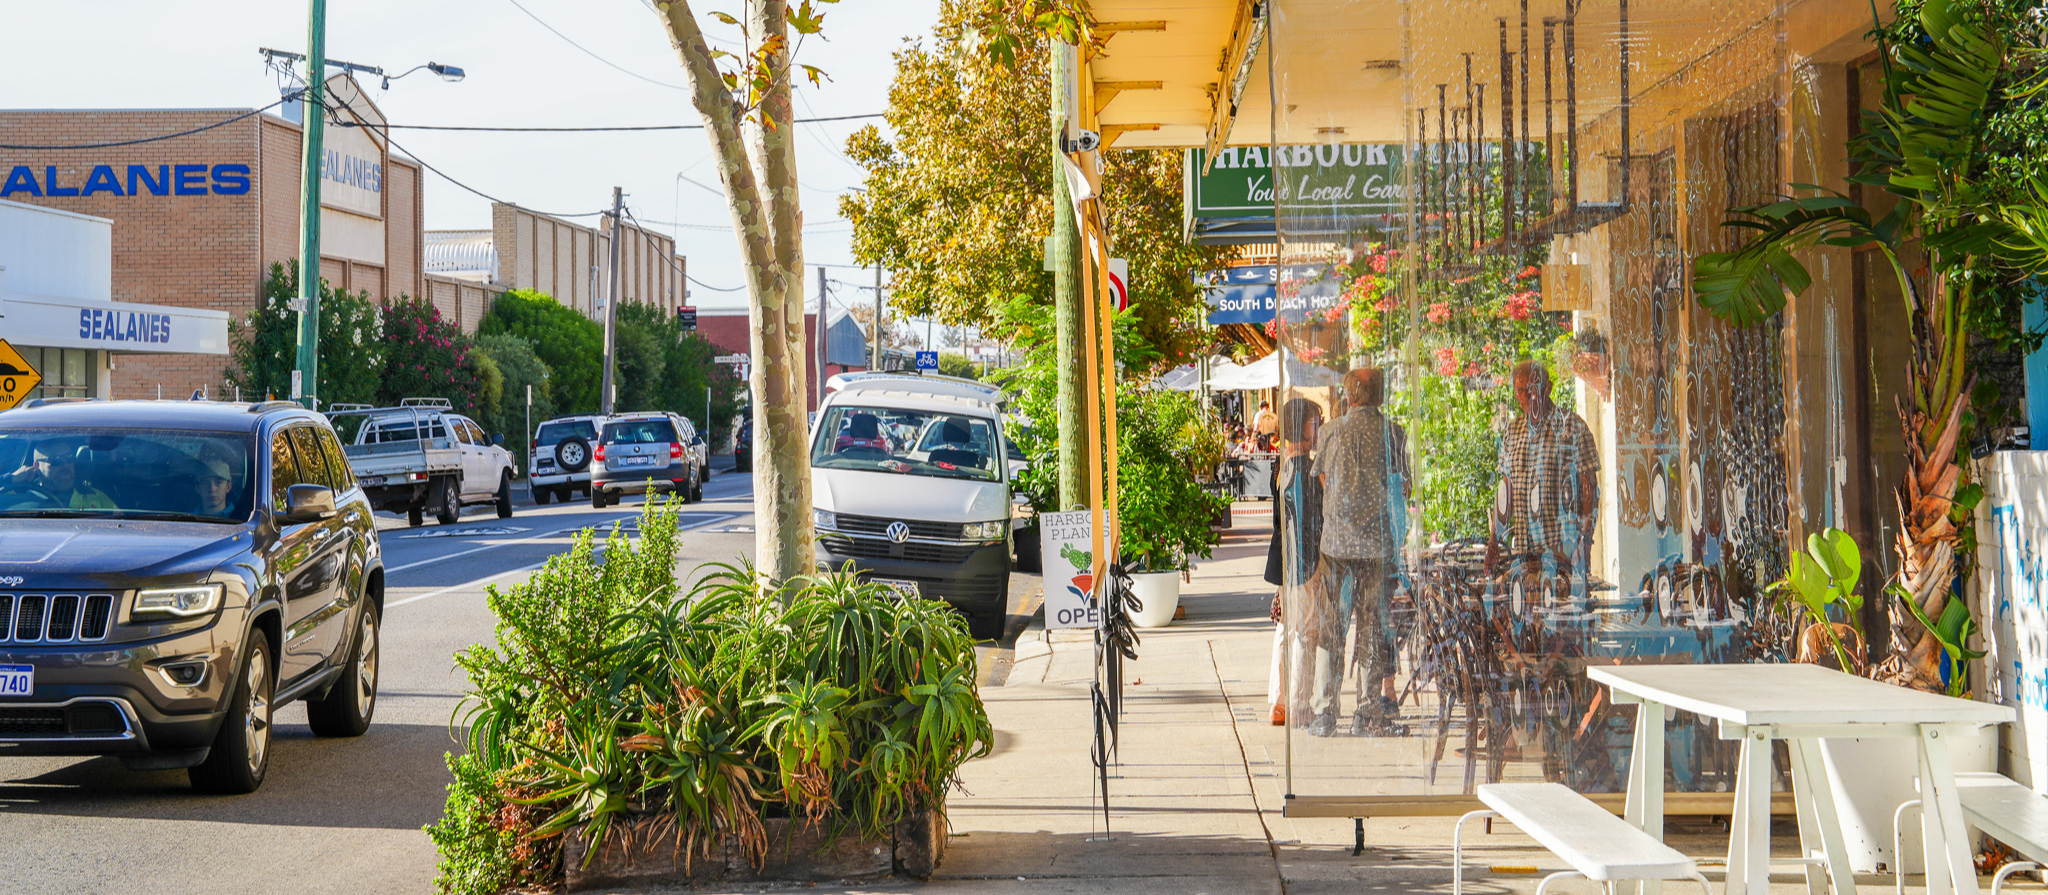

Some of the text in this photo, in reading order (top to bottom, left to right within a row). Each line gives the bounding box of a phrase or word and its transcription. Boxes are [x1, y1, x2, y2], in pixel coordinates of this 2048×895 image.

[1214, 145, 1388, 168] HARBOUR
[1247, 174, 1290, 202] Your
[1298, 174, 1356, 200] Local
[1219, 299, 1260, 311] SOUTH
[80, 308, 171, 343] SEALANES
[1052, 526, 1110, 540] PLANS
